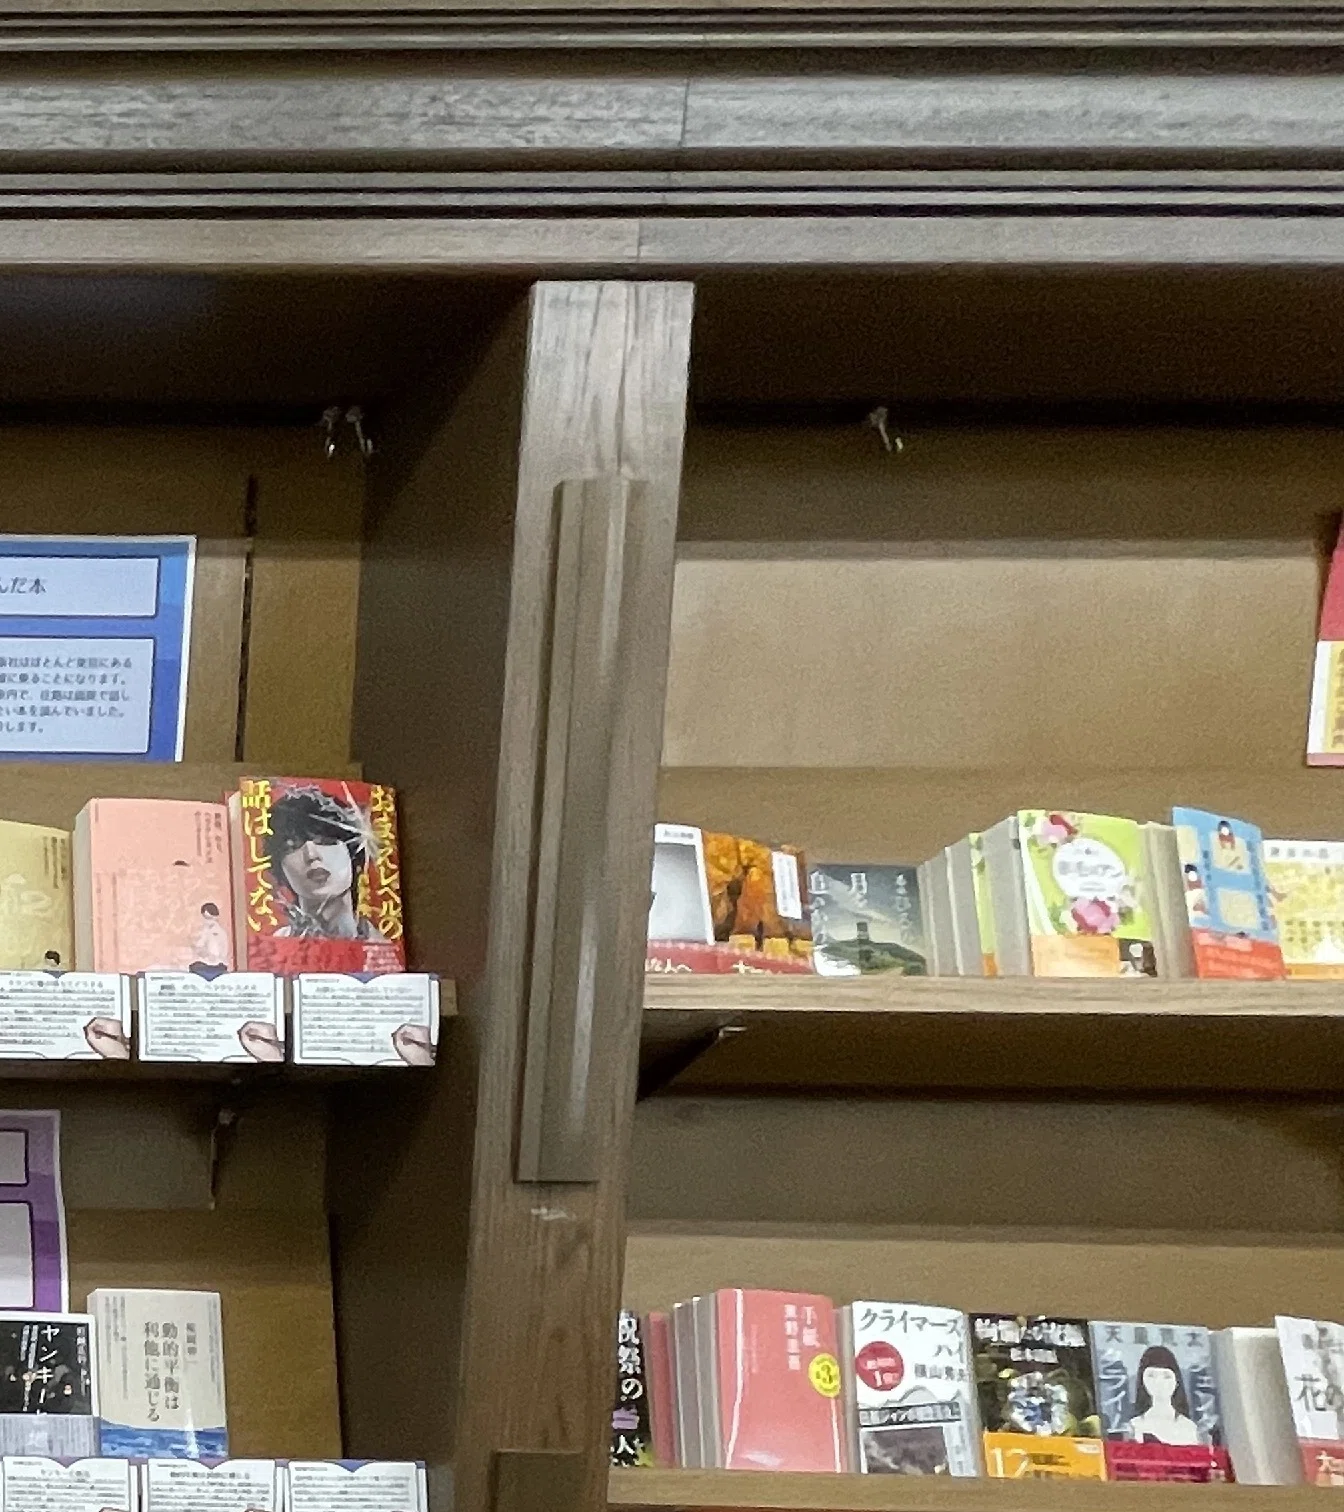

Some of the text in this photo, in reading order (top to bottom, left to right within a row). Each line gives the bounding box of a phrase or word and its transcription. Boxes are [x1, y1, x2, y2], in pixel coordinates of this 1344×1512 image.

[241, 779, 278, 933] 話はしてない
[161, 1321, 180, 1411] 動的平衡は
